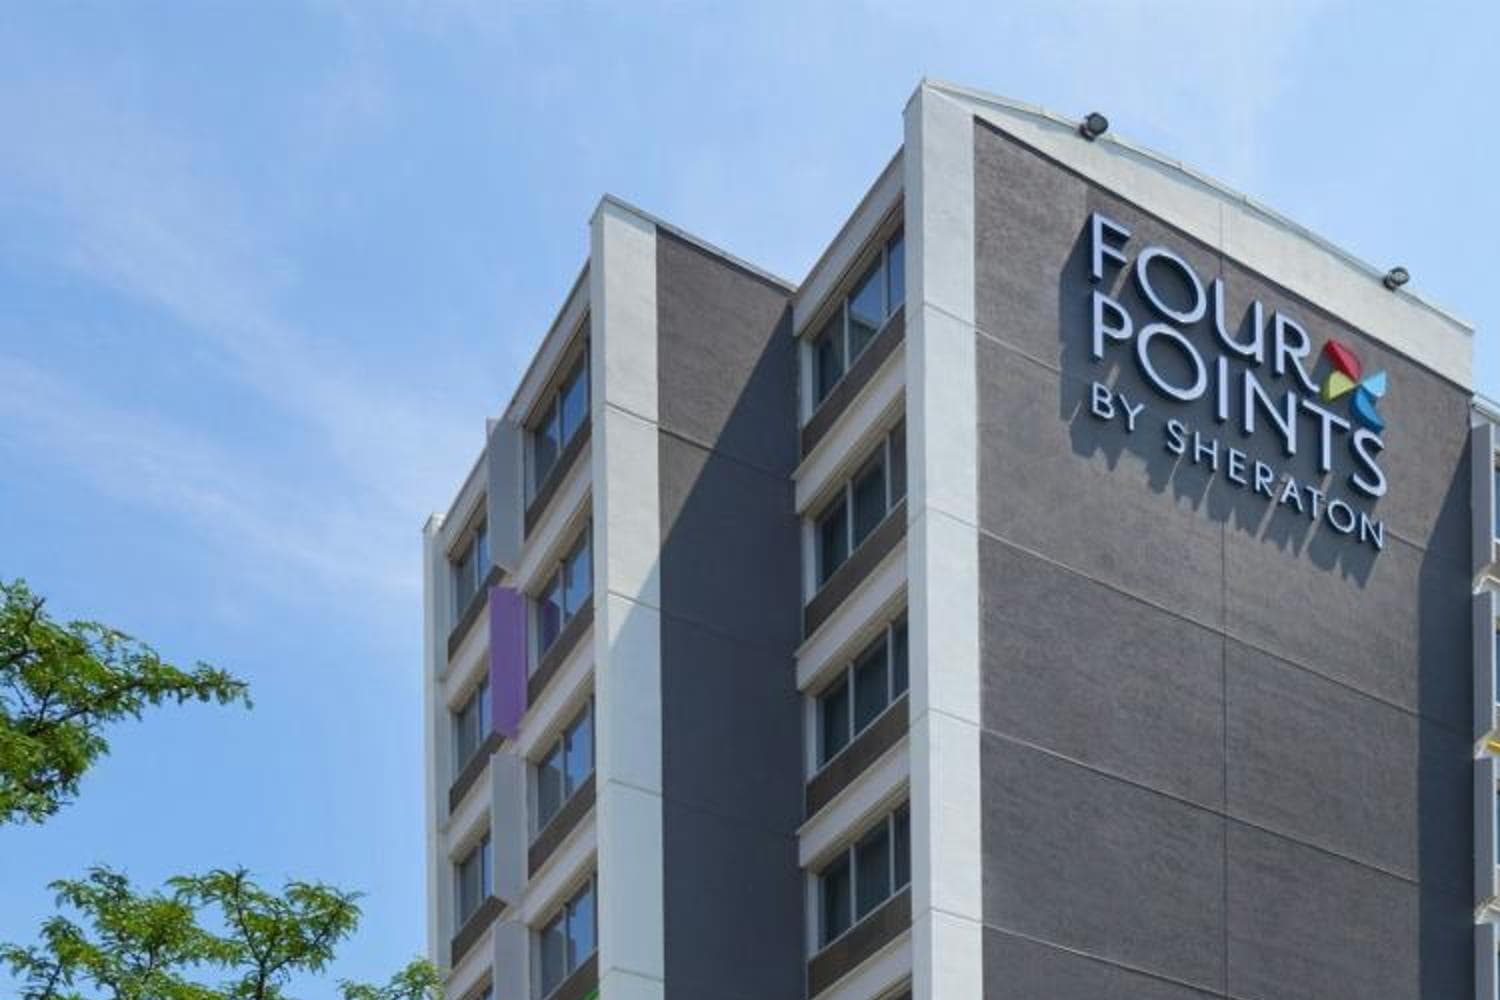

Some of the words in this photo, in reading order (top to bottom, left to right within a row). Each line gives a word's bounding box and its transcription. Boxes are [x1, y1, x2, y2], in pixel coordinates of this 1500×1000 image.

[1093, 212, 1321, 393] FOUR
[1093, 289, 1388, 496] POINTS
[1093, 382, 1145, 431] BY
[1166, 419, 1384, 549] SHERATON
